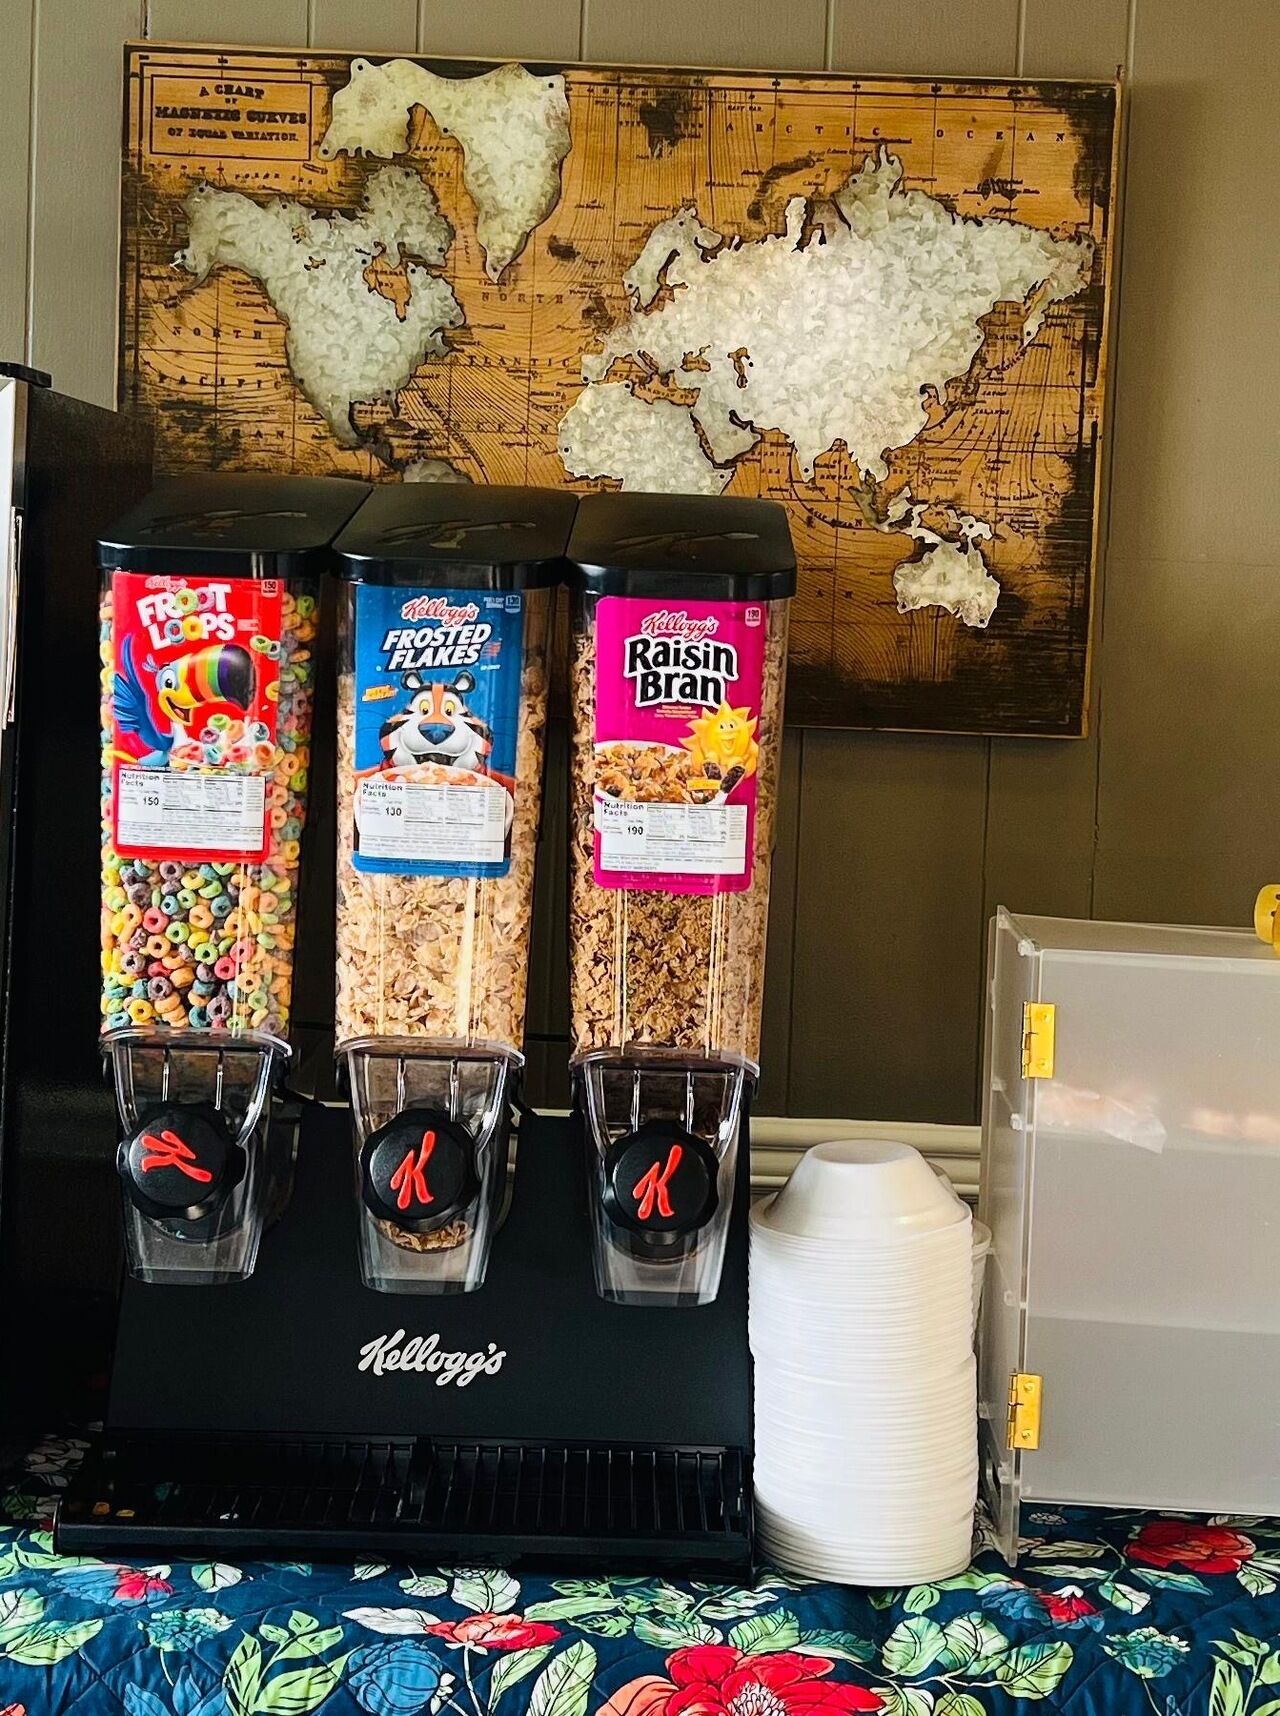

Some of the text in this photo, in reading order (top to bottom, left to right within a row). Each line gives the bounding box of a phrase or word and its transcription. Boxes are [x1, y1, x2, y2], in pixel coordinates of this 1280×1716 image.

[199, 84, 265, 100] A CHART
[155, 106, 308, 125] MAGNETIC CURVES
[726, 122, 1066, 143] ARCTIC OCEAN
[482, 291, 564, 305] NORTH
[173, 326, 262, 340] NORTH
[158, 372, 282, 390] PACIFIC
[136, 583, 232, 628] FROOT
[402, 596, 479, 625] Kellogg's
[147, 612, 236, 650] LOOPS
[643, 611, 717, 639] Kellogg's
[382, 624, 492, 651] FROSTED
[388, 644, 482, 670] FLAKES
[628, 638, 735, 677] Raisin
[639, 670, 722, 706] Bran
[121, 772, 160, 781] Nutrition
[362, 783, 403, 791] Nutrition
[143, 796, 160, 806] 150
[603, 801, 644, 810] Nutrition
[385, 807, 402, 817] 130
[627, 826, 644, 836] 190
[390, 1130, 436, 1209] K
[632, 1144, 682, 1220] K
[357, 1328, 507, 1388] Kellogg's
